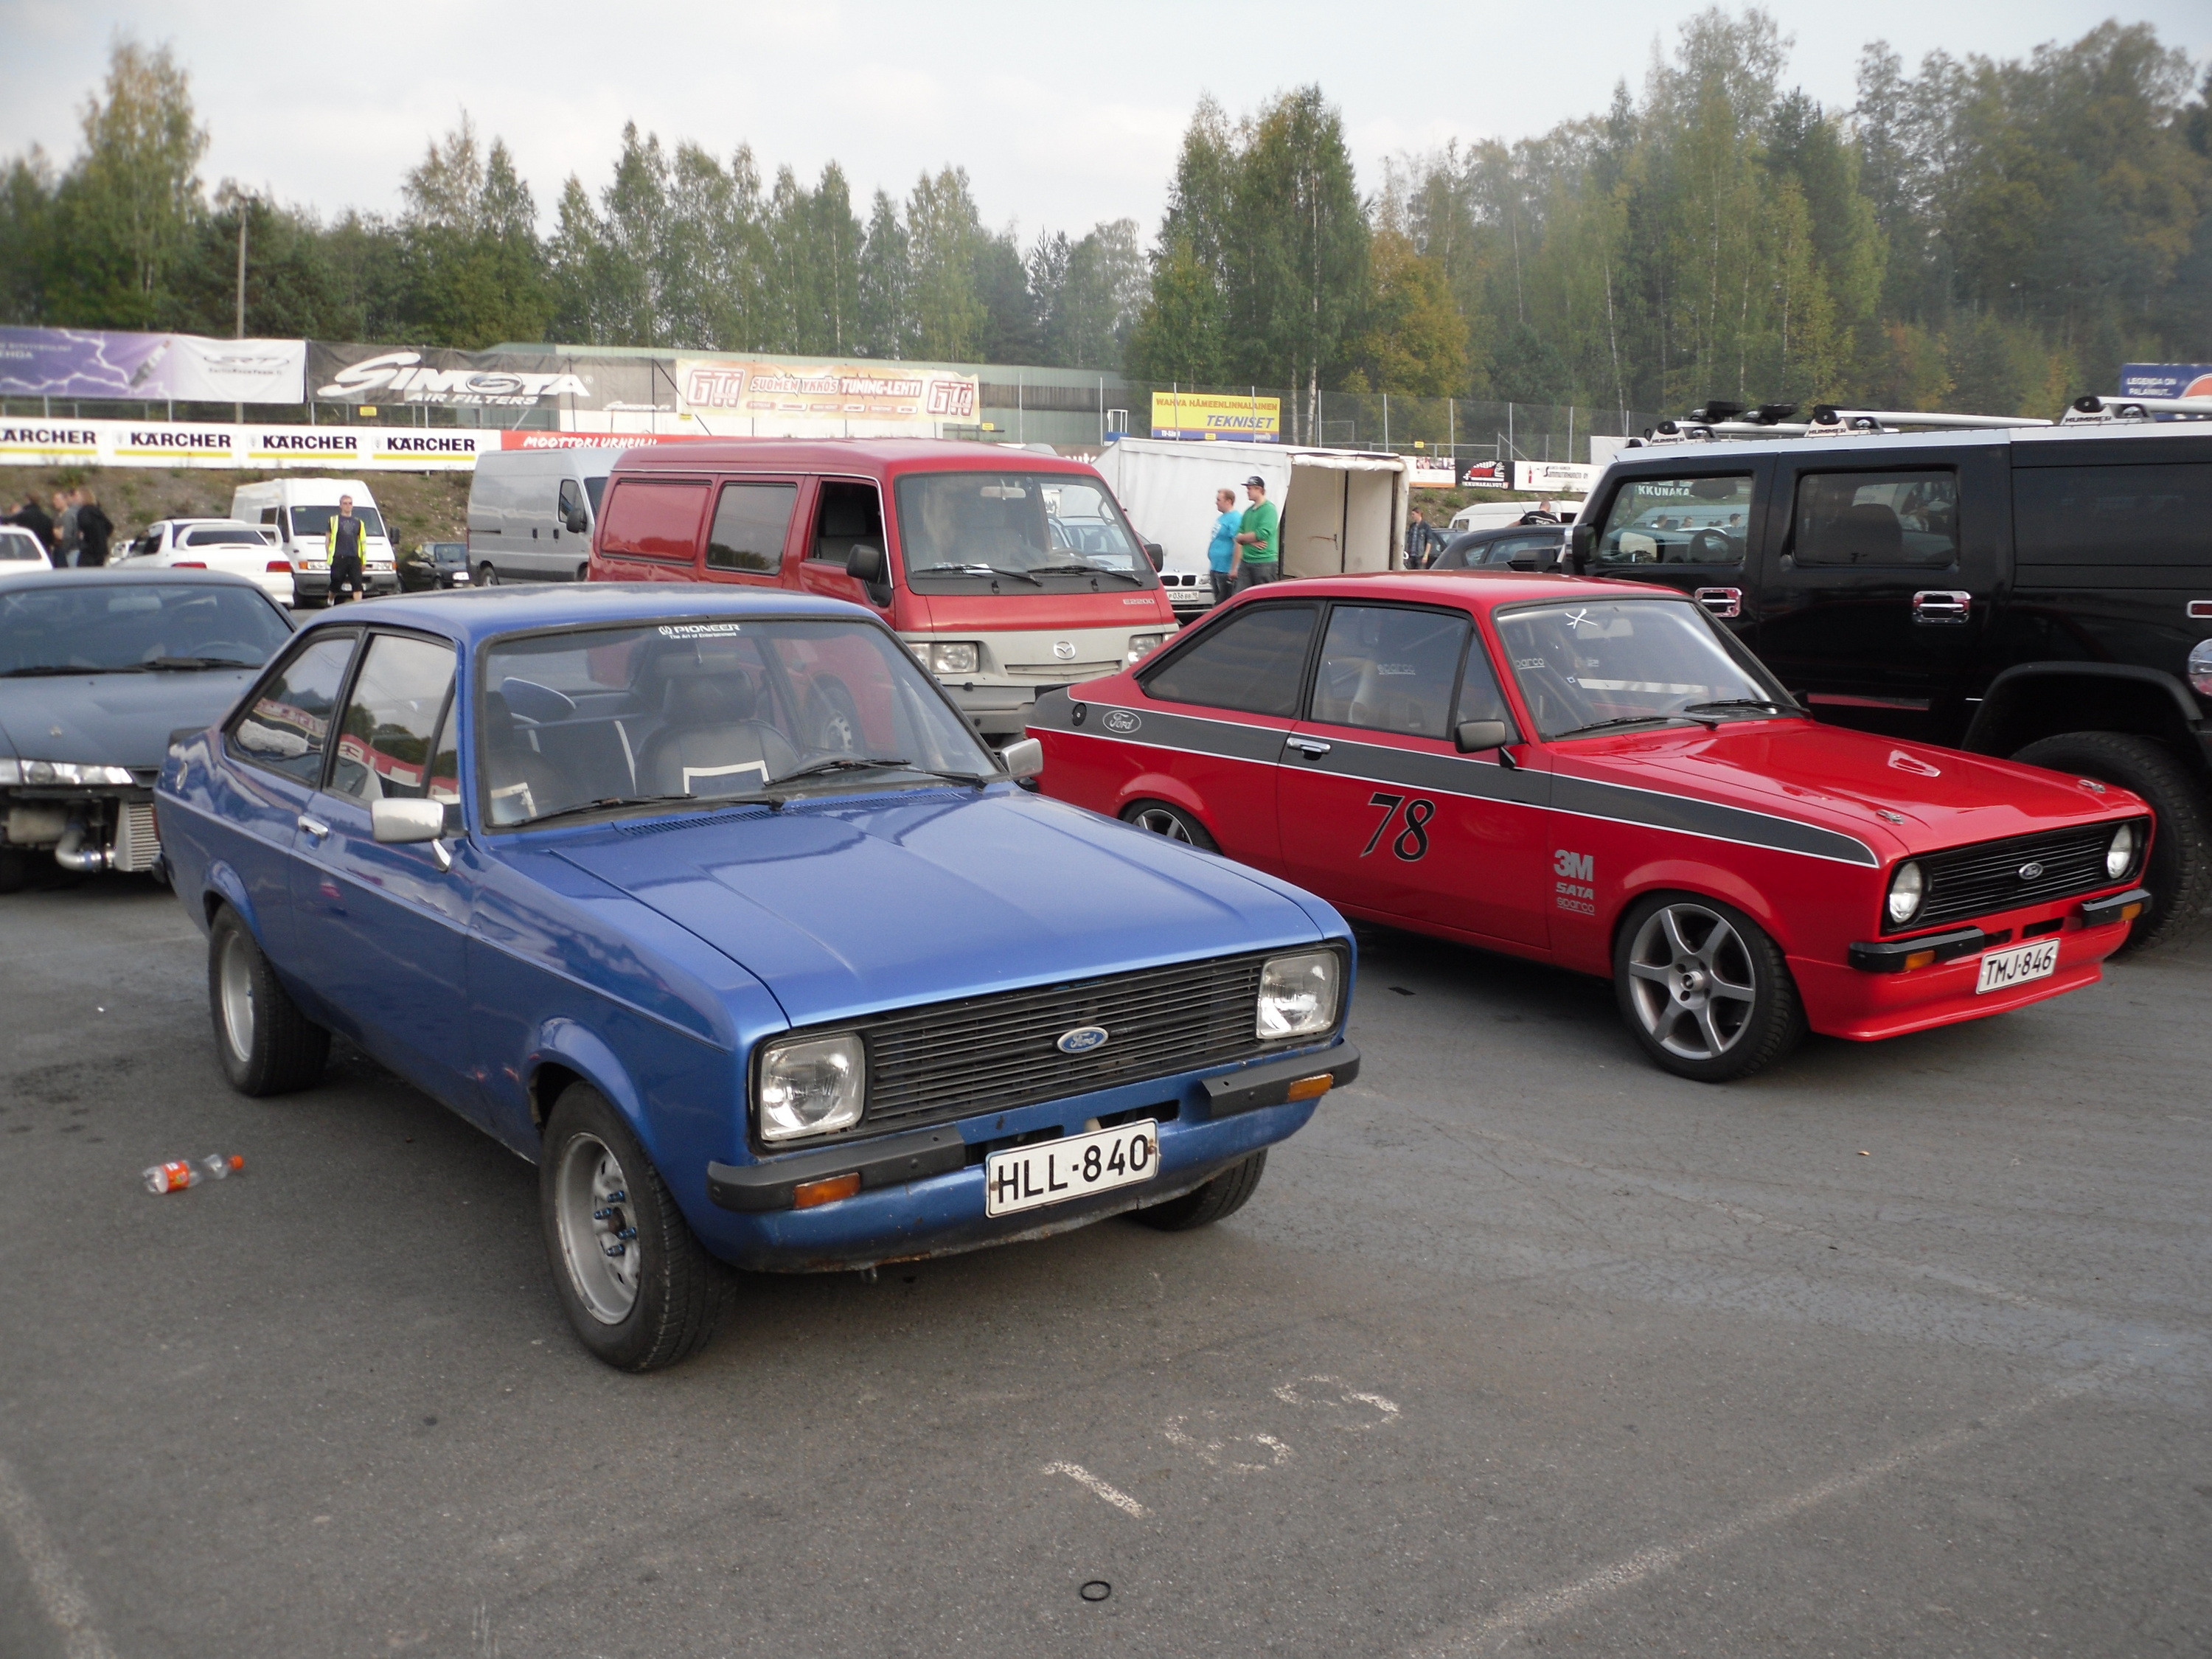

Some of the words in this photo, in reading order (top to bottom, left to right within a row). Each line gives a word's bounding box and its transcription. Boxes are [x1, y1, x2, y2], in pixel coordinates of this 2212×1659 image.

[751, 375, 801, 393] SUOMEN
[801, 376, 838, 393] YKKÖS
[841, 378, 921, 397] TUNING-LEHTI
[406, 392, 447, 403] AIR
[451, 394, 539, 405] FILTERS
[1206, 414, 1275, 429] TEKNISET
[0, 428, 97, 444] ÄRCHER
[131, 431, 232, 448] KÄRCHER
[263, 434, 357, 449] KÄRCHER
[387, 437, 476, 451] KÄRCHER
[674, 624, 740, 633] PIONEER
[1514, 658, 1544, 668] parco
[1110, 712, 1134, 729] Ford
[1360, 791, 1436, 862] 78
[1554, 849, 1594, 882] 3M
[1556, 882, 1594, 900] SATA
[1986, 946, 2054, 985] TMJ-846
[1070, 1032, 1097, 1048] Ford
[998, 1134, 1149, 1203] HLL-840
